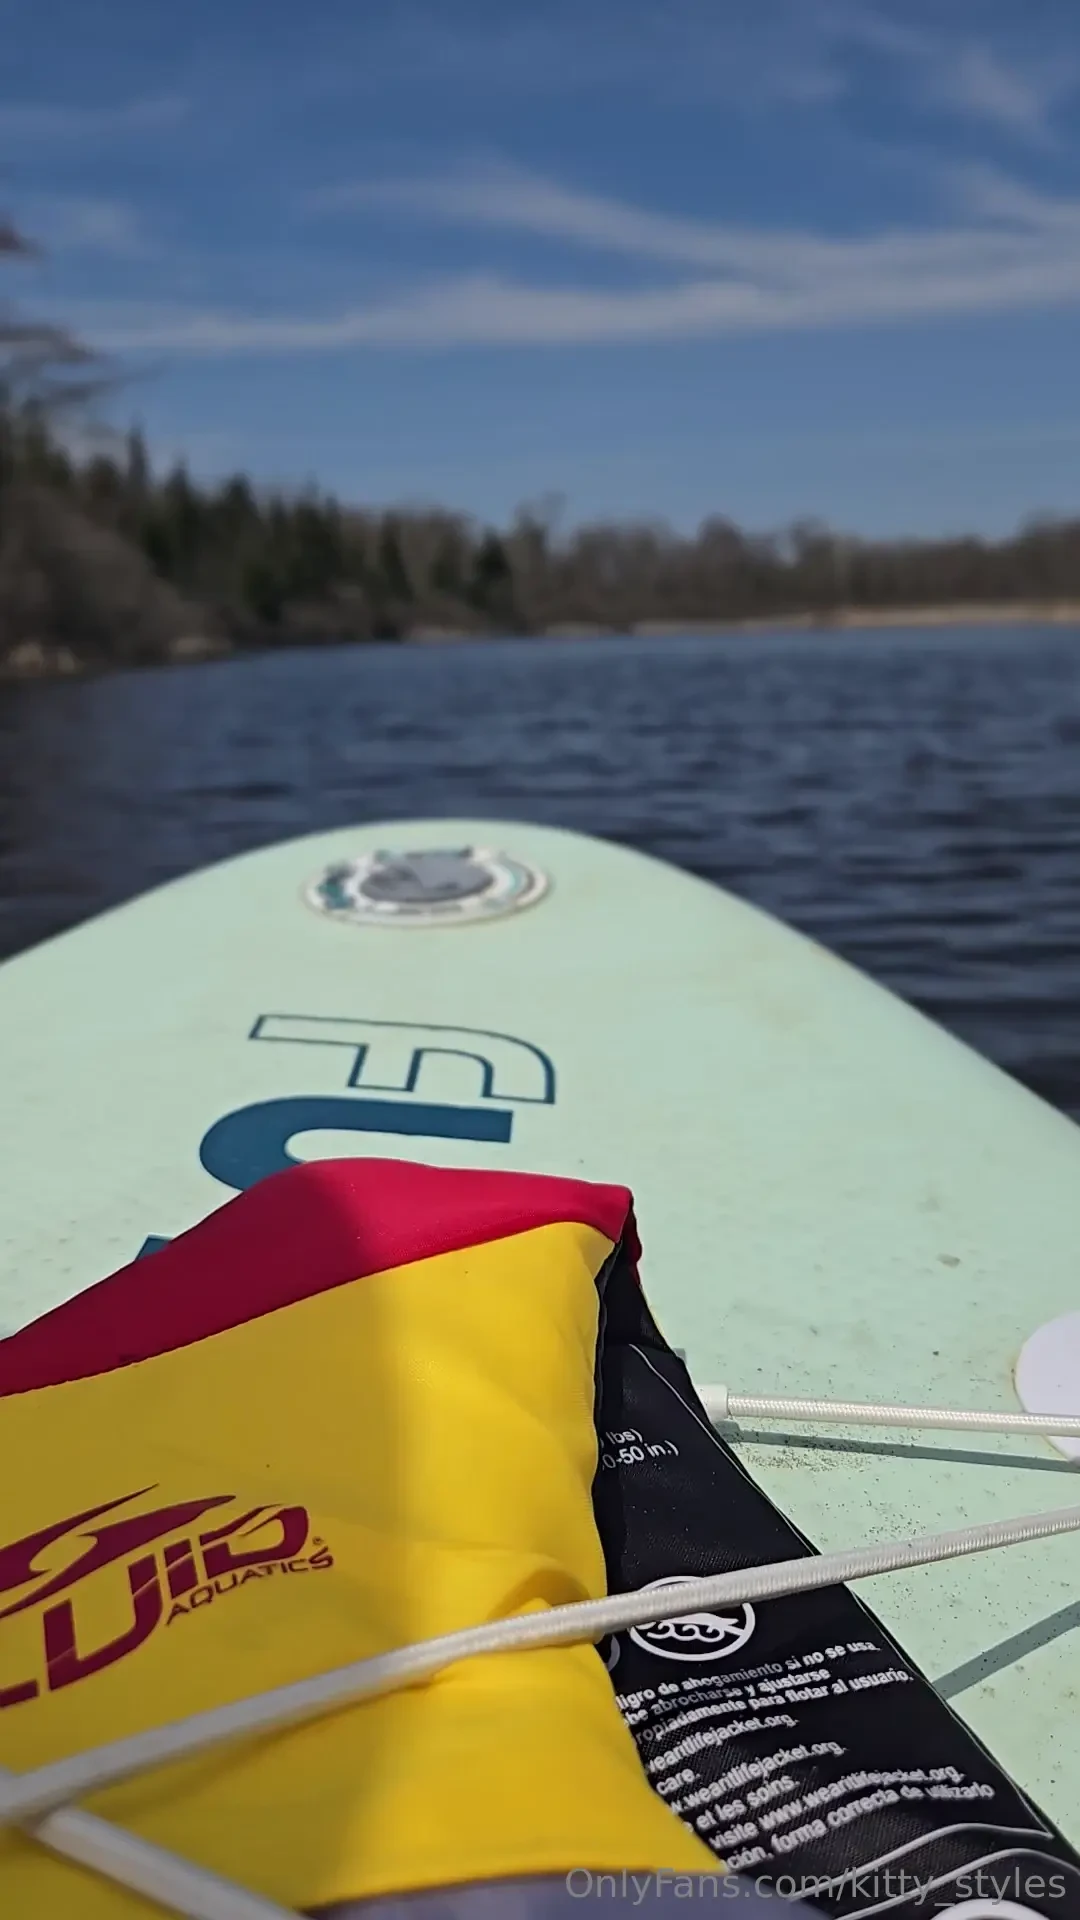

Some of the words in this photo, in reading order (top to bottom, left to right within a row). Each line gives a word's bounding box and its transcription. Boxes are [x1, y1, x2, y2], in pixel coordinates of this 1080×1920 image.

[602, 1446, 645, 1471] 0-50
[644, 1440, 679, 1458] in.)
[166, 1546, 334, 1627] AQUATICS
[651, 1687, 743, 1716] abrocharse
[744, 1684, 756, 1698] y
[757, 1668, 831, 1695] ajustarse
[658, 1682, 680, 1696] de
[681, 1662, 783, 1691] ahogamiento
[785, 1655, 803, 1671] si
[802, 1651, 825, 1666] no
[825, 1644, 847, 1659] se
[748, 1694, 786, 1711] para
[785, 1685, 830, 1703] flotar
[831, 1678, 849, 1695] al
[848, 1667, 914, 1691] usuario.
[656, 1768, 701, 1795] care.
[696, 1809, 717, 1830] et
[715, 1799, 747, 1822] les
[747, 1775, 800, 1808] soins.
[709, 1824, 759, 1850] visite
[771, 1818, 827, 1853] forma
[827, 1789, 900, 1829] correcta
